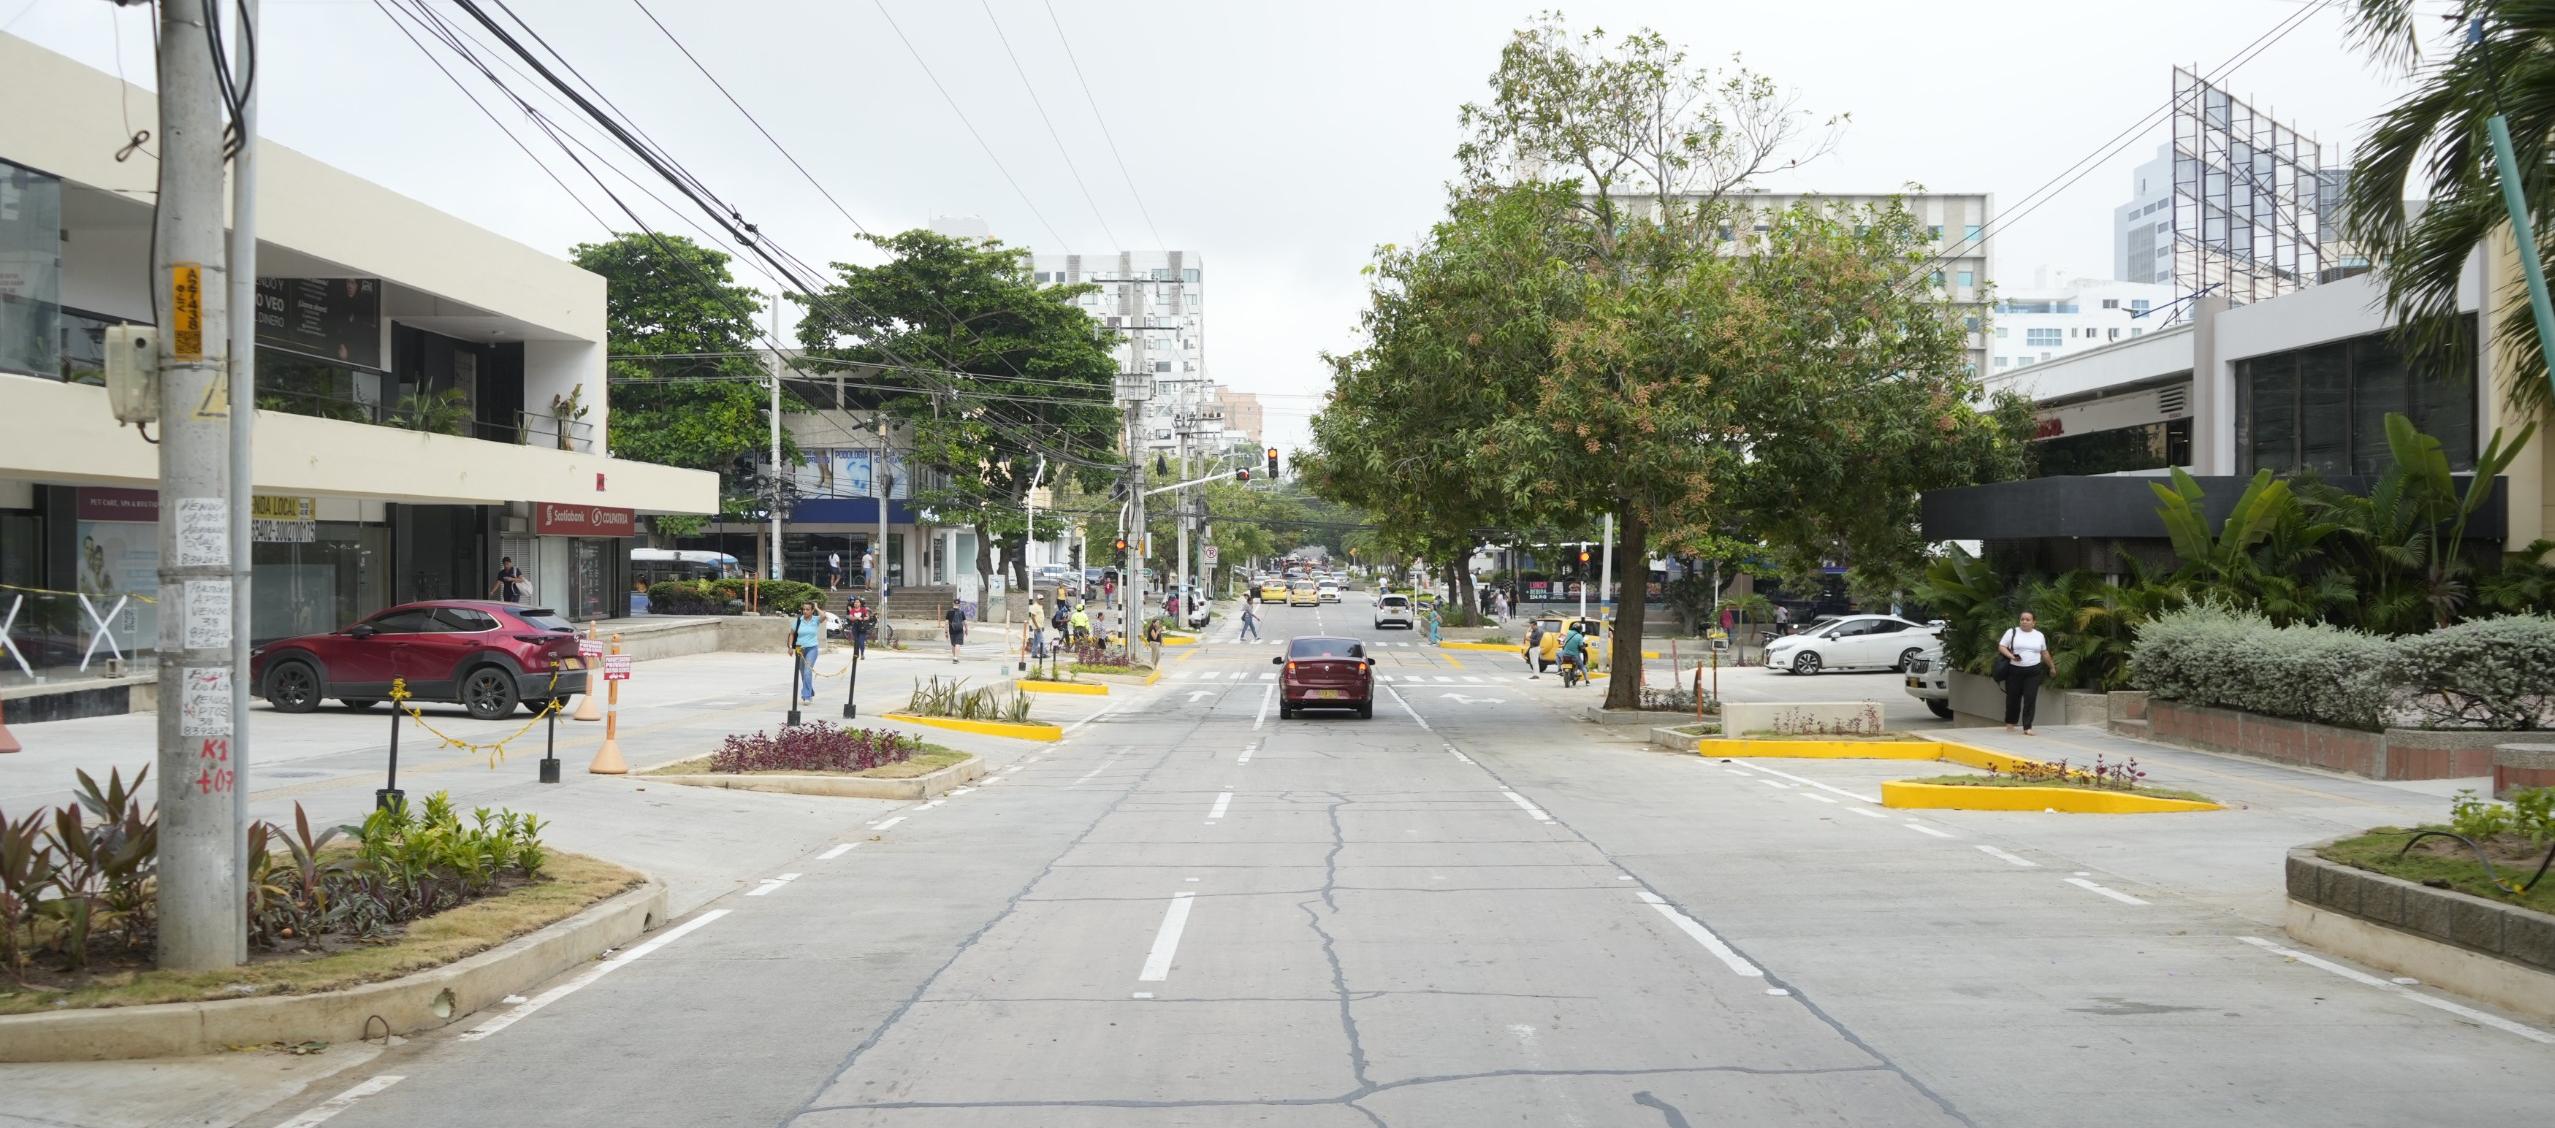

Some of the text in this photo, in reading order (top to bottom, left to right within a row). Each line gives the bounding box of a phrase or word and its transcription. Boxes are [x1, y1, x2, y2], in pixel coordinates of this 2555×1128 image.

[266, 295, 285, 312] VEO
[259, 311, 285, 328] DINERO
[835, 448, 868, 459] PODOLOGÍA
[273, 497, 296, 516] LOCAL
[554, 505, 629, 525] Scotiabank COLPATRIA
